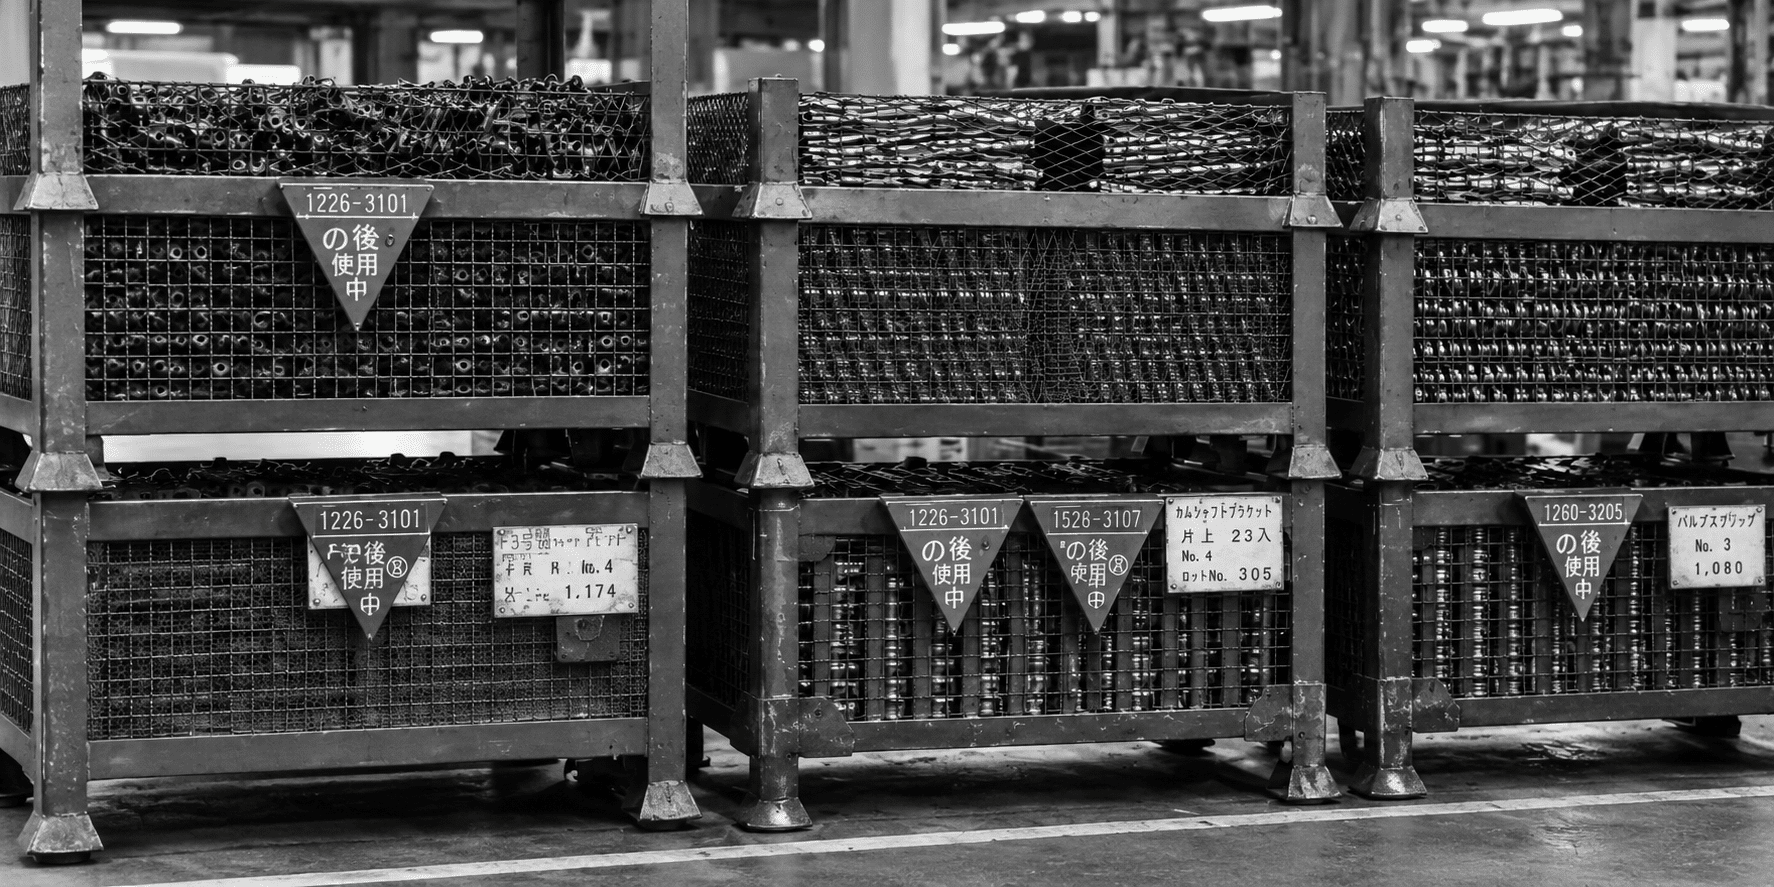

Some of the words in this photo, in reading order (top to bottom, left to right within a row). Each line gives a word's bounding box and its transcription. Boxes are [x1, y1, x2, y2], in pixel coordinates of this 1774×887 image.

[307, 193, 406, 213] 1226-3101
[323, 224, 379, 251] の後
[332, 253, 377, 276] 使用
[346, 276, 367, 302] 中
[320, 509, 418, 530] 1226-3101
[910, 507, 996, 526] 1226-3101
[1545, 503, 1622, 521] 1260-3205
[1182, 528, 1214, 543] 片上
[1557, 530, 1601, 554] の後
[1694, 537, 1714, 554] No.
[1722, 536, 1732, 553] 3
[922, 536, 972, 561] の後
[1067, 539, 1108, 560] の後
[1180, 548, 1201, 564] No.
[1203, 549, 1214, 563] 4
[603, 557, 614, 575] 4
[933, 563, 970, 585] 使用
[1239, 567, 1271, 581] 305
[1565, 556, 1599, 577] 使用
[1696, 561, 1742, 576] 1,080
[342, 566, 383, 589] 使用
[566, 584, 616, 599] 1,174
[944, 585, 964, 610] 中
[1574, 577, 1593, 601] 中
